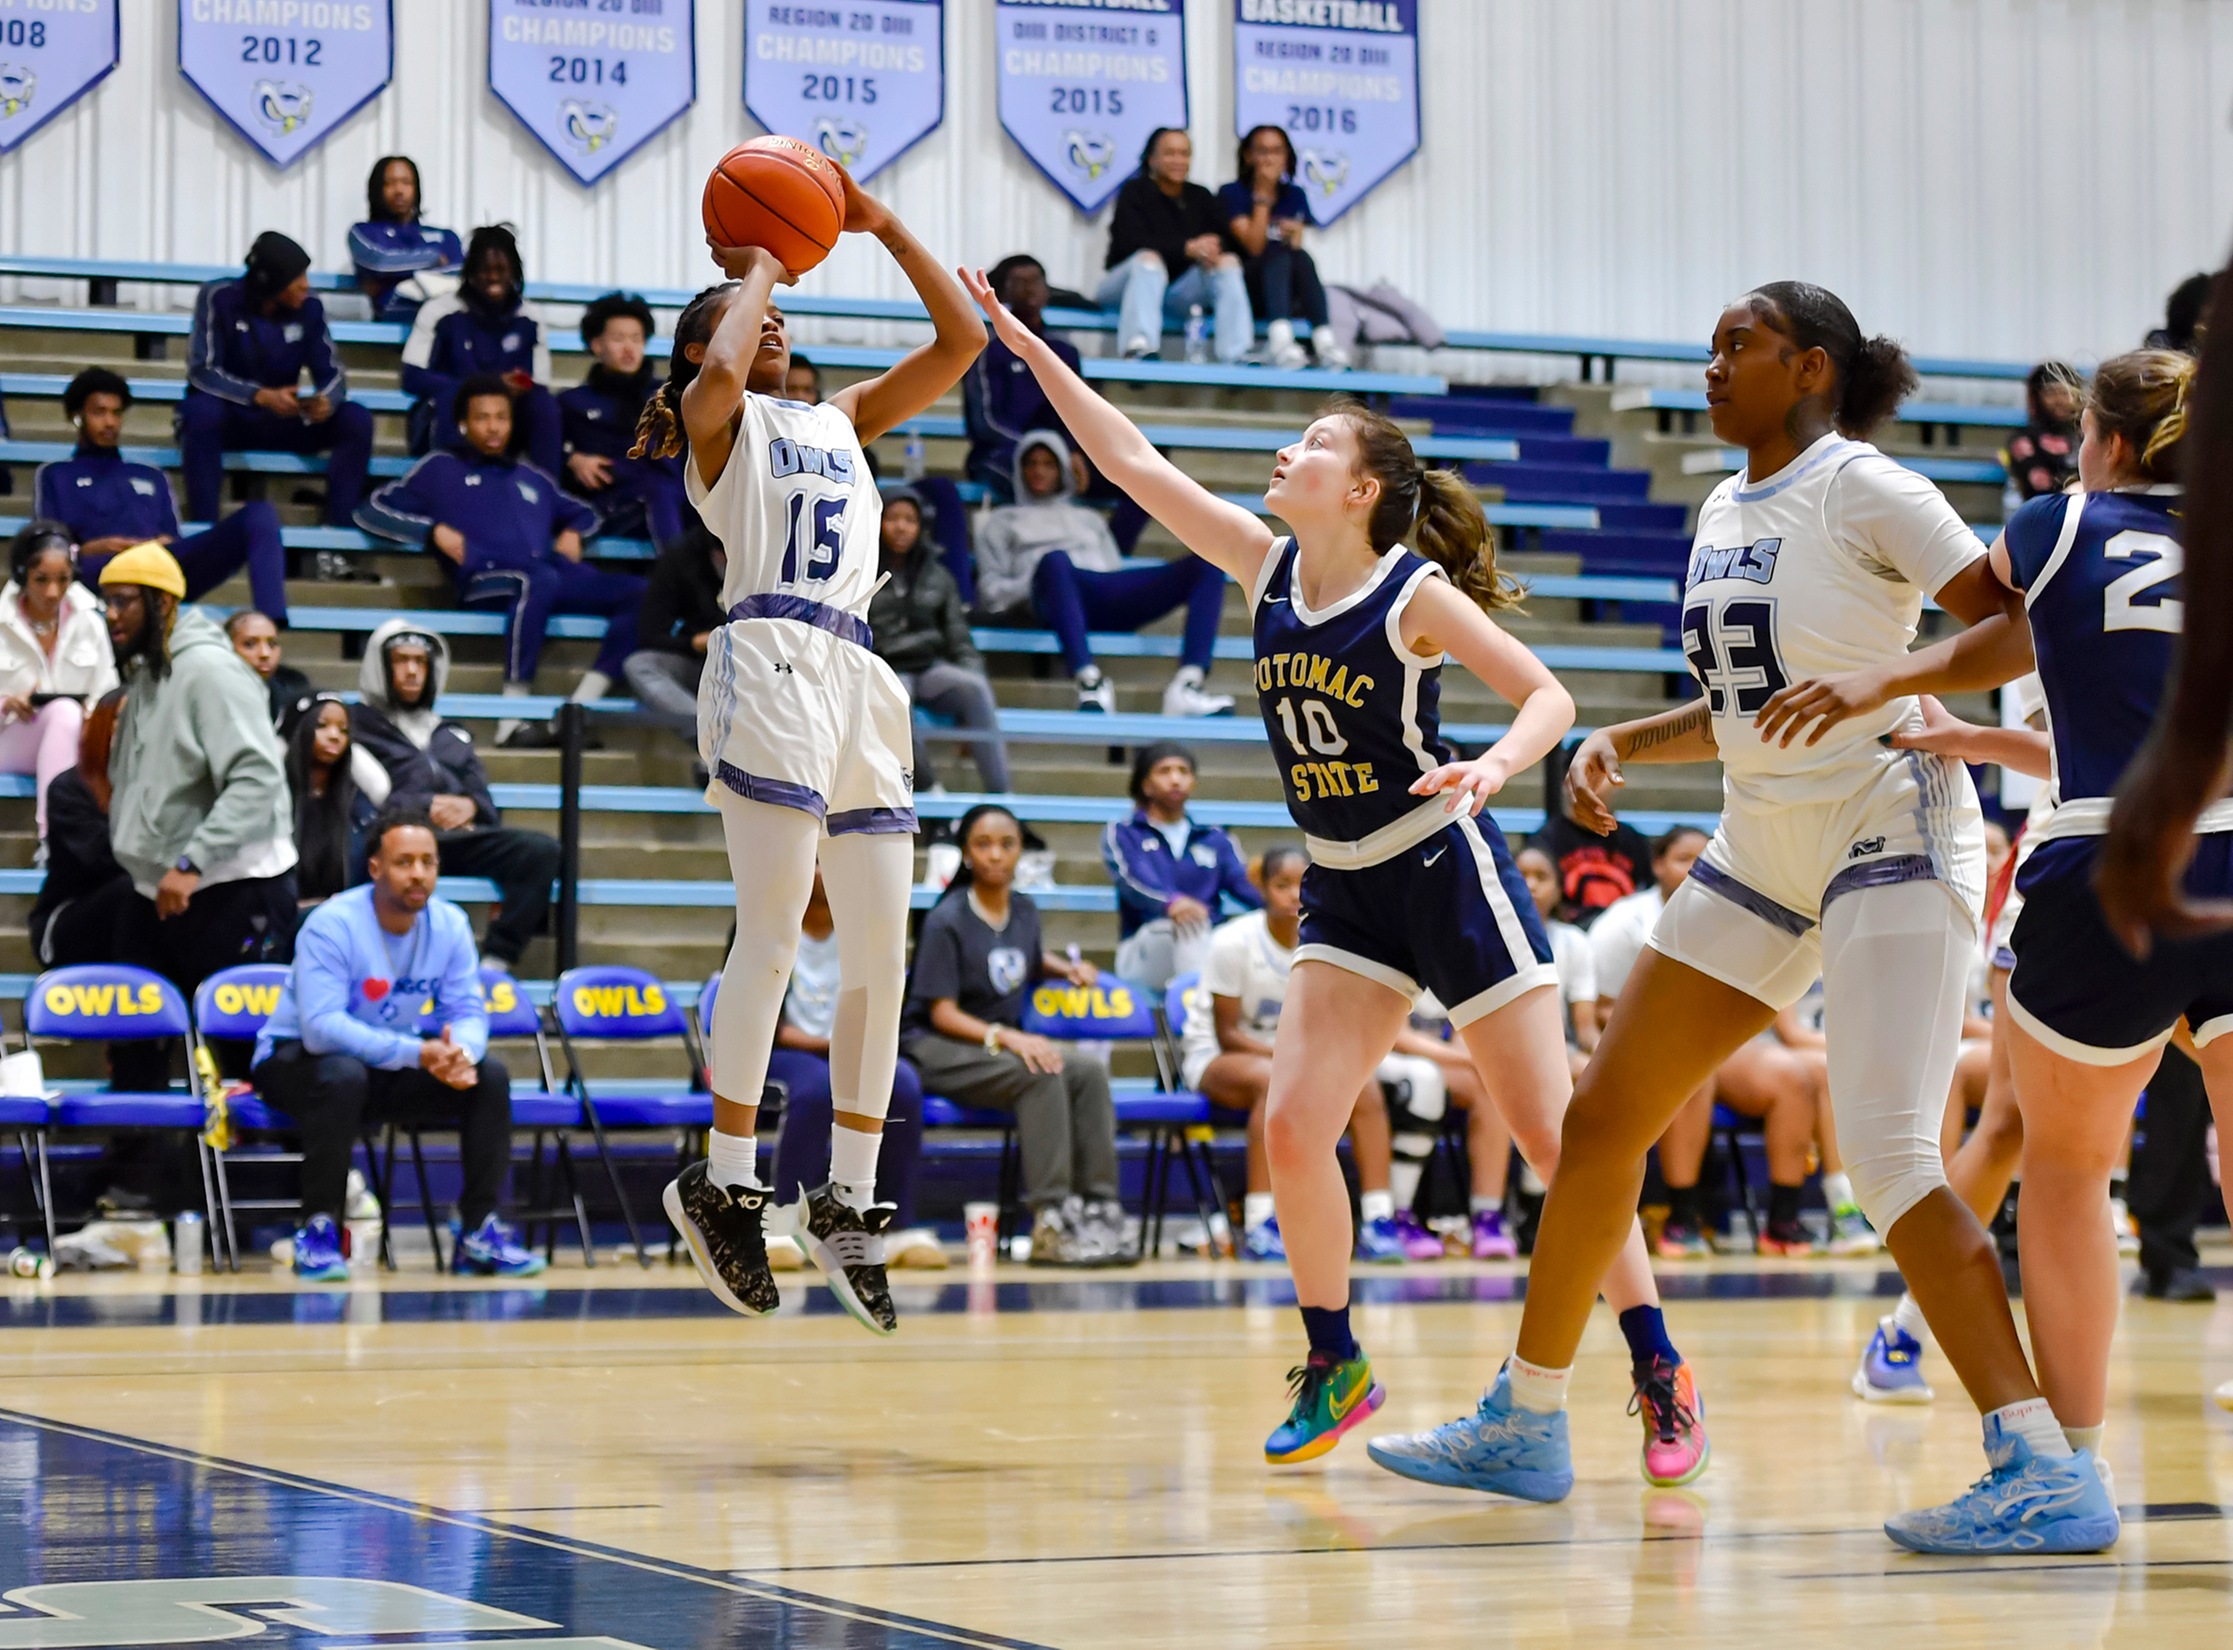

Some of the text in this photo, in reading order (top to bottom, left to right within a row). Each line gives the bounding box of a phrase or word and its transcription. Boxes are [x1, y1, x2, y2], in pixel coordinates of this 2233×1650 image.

[191, 0, 374, 31] CHAMPIONS
[769, 6, 841, 28] REGION
[850, 13, 873, 32] 20
[1241, 0, 1404, 32] BASKETBALL
[0, 20, 45, 47] 08
[502, 15, 677, 53] CHAMPIONS
[1054, 25, 1138, 46] DISTRICT
[242, 36, 322, 65] 2012
[756, 33, 926, 73] CHAMPIONS
[1006, 50, 1169, 83] CHAMPIONS
[1255, 41, 1321, 61] REGION
[1330, 45, 1353, 64] 20
[550, 56, 627, 86] 2014
[1245, 66, 1402, 103] CHAMPIONS
[802, 74, 877, 104] 2015
[1052, 87, 1124, 115] 2015
[1286, 105, 1358, 134] 2016
[769, 437, 856, 487] OWLS
[777, 488, 850, 588] 15
[1685, 537, 1783, 594] OWLS
[1276, 697, 1349, 757] 10
[45, 984, 163, 1017] OWLS
[214, 984, 281, 1015] OW
[573, 984, 667, 1017] OWLS
[1032, 987, 1135, 1019] OWLS
